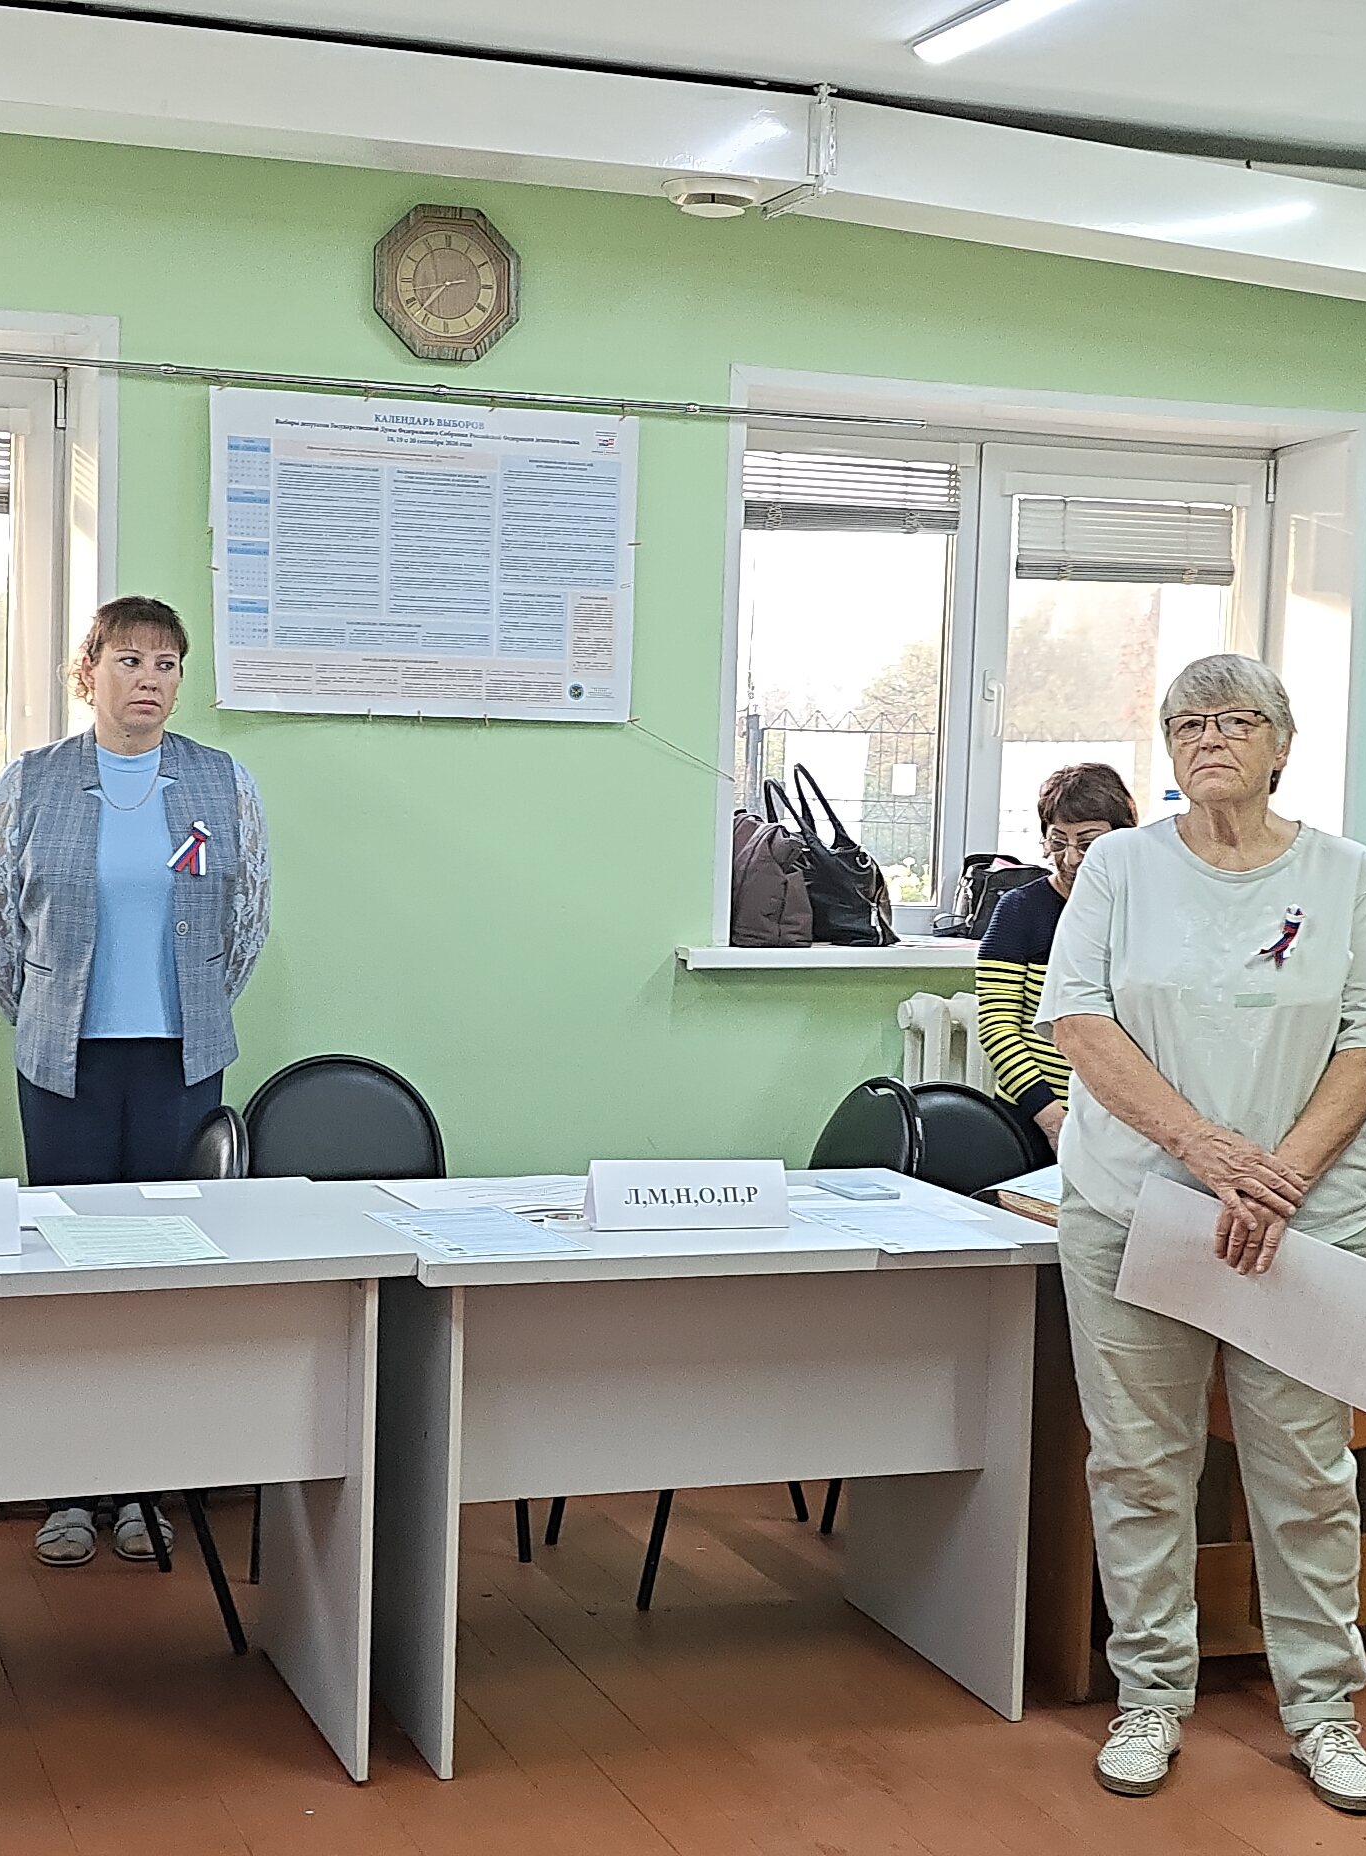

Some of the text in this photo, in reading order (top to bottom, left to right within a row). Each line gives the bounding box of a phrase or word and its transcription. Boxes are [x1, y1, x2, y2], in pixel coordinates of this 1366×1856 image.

[374, 413, 485, 430] КАЛЕНДАРЬ ВЫБОРОВ
[624, 1186, 759, 1208] Л,М,Н,О,П,Р
